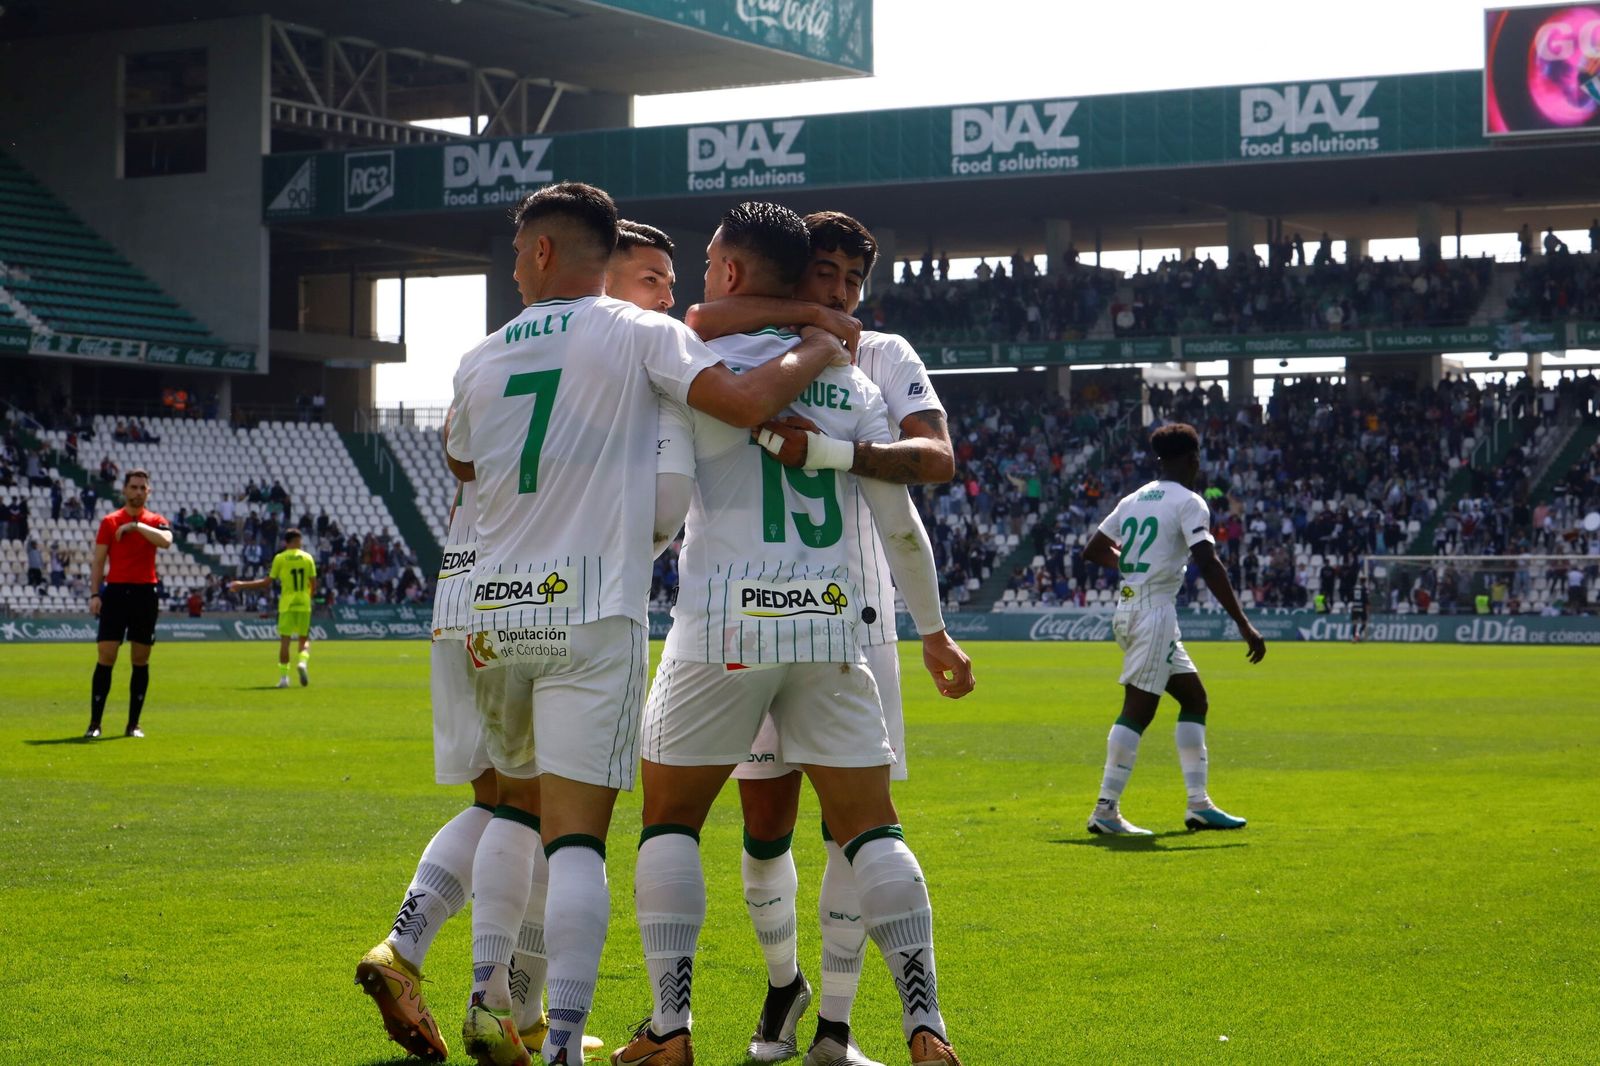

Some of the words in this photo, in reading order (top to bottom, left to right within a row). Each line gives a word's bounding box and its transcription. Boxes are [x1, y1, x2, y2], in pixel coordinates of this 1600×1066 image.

[1240, 81, 1379, 137] DIAZ
[952, 101, 1079, 155] DIAZ
[687, 120, 805, 173] DIAZ
[1240, 136, 1284, 158] food
[1290, 133, 1379, 154] solutions
[443, 138, 553, 188] DIAZ
[952, 155, 993, 175] food
[998, 152, 1079, 173] solutions
[349, 165, 388, 195] RG3
[687, 170, 724, 191] food
[730, 169, 805, 188] solutions
[443, 187, 478, 206] food
[505, 311, 574, 344] WILLY
[1450, 334, 1489, 344] SILBO
[795, 380, 852, 411] QUEZ
[503, 368, 562, 494] 7
[749, 436, 843, 548] 19
[1119, 516, 1159, 574] 22
[442, 550, 476, 570] EDRA
[290, 567, 305, 592] 11
[22, 622, 97, 639] CaixaBank
[498, 627, 566, 643] Diputación
[500, 645, 515, 657] de
[515, 642, 567, 657] Córdoba
